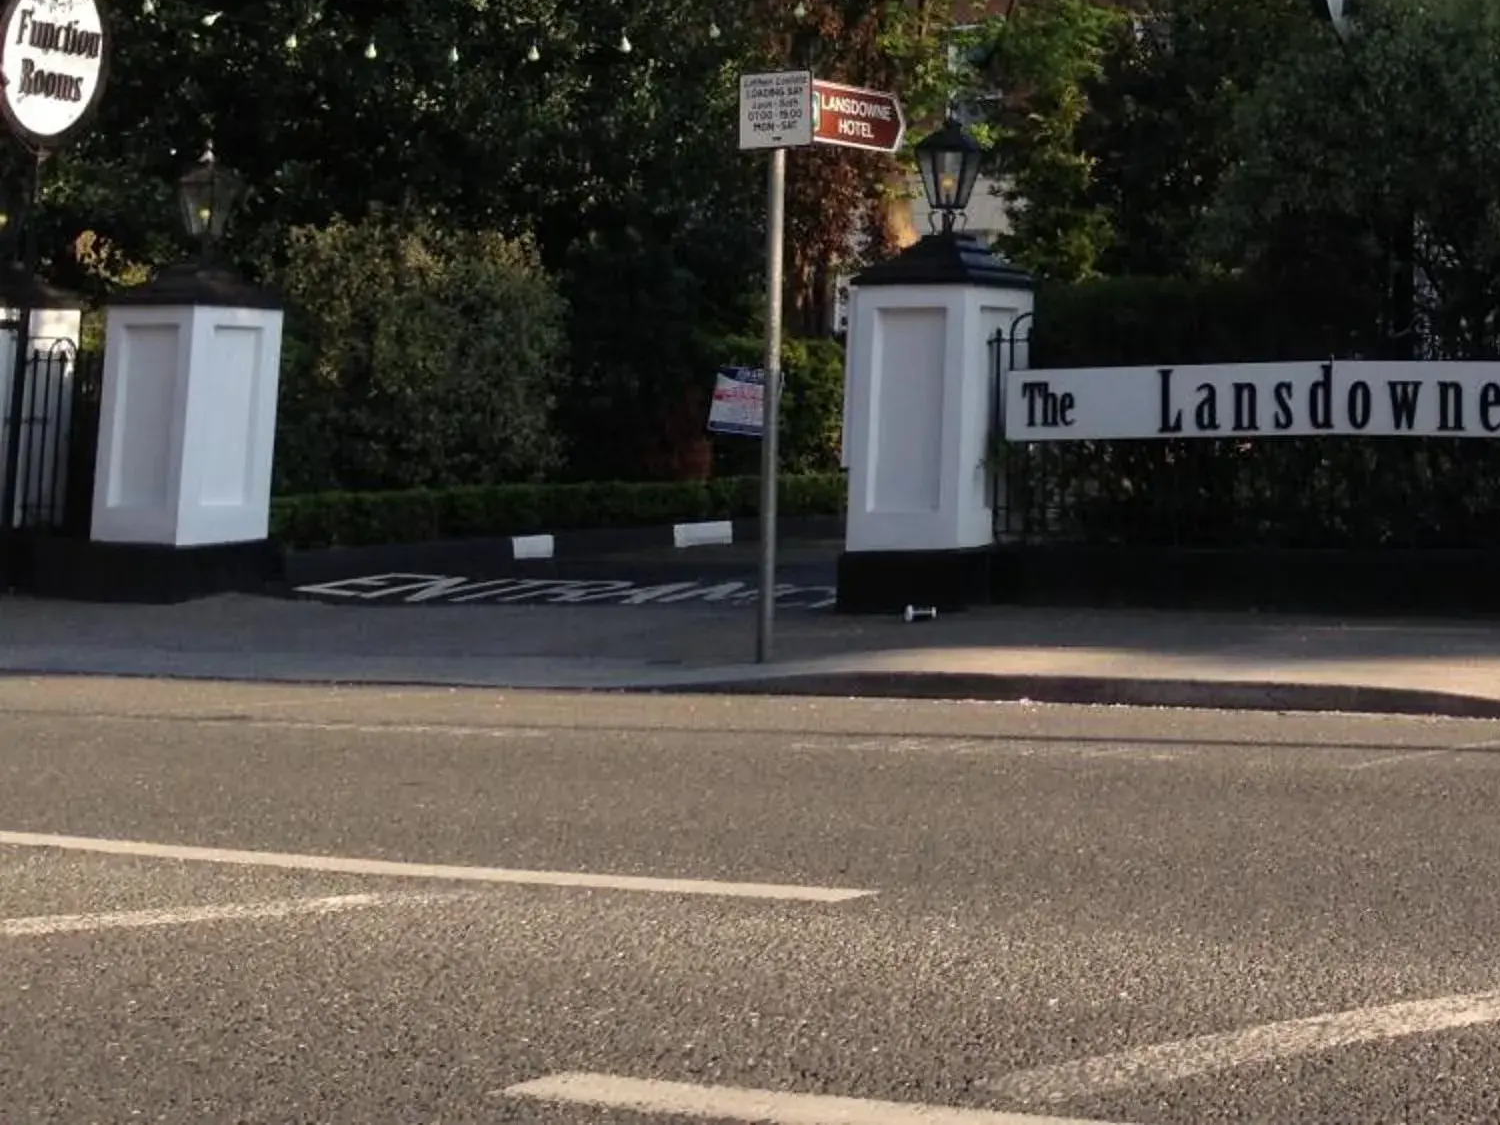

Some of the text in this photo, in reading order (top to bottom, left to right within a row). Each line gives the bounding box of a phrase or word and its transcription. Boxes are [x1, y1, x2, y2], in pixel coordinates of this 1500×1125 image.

[16, 9, 101, 59] Function
[18, 58, 83, 102] Rooms
[821, 92, 892, 122] LANSDOWNE
[838, 118, 875, 138] HOTEL
[1022, 381, 1076, 428] The
